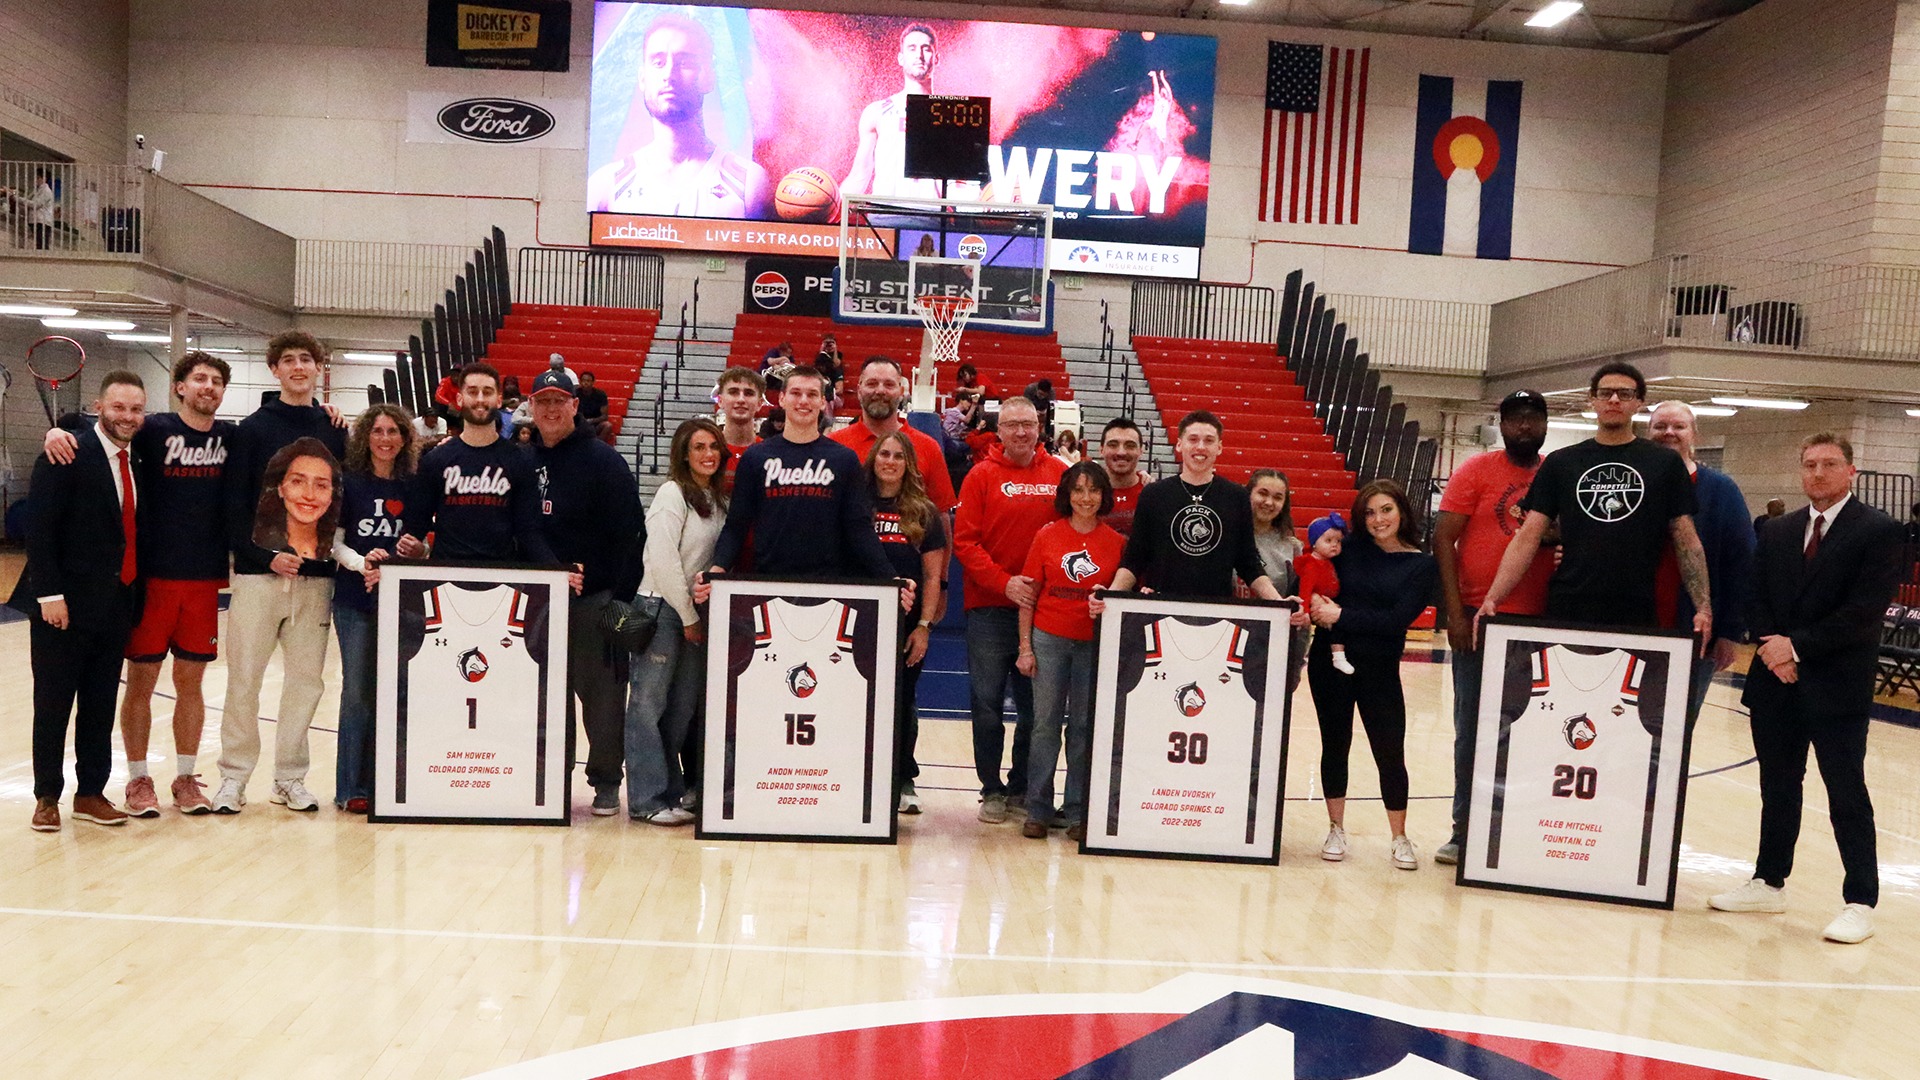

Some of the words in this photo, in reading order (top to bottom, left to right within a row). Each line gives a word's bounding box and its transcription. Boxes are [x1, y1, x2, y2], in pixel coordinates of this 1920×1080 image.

[470, 31, 510, 41] BARBECUE
[511, 33, 525, 42] PIT
[460, 104, 532, 135] Ford
[930, 103, 982, 127] 5:00
[946, 144, 1182, 214] WERY
[609, 221, 678, 239] uchealth
[706, 229, 740, 243] LIVE
[746, 231, 886, 251] EXTRAORDINARY
[960, 245, 985, 253] PEPSI
[1106, 250, 1180, 263] FARMERS
[1105, 262, 1155, 271] INSURANCE
[754, 285, 788, 295] PEPSI
[164, 434, 228, 466] Pueblo
[763, 457, 835, 487] Pueblo
[443, 465, 511, 495] Pueblo
[765, 486, 833, 498] BASKETBALL
[1014, 483, 1058, 496] PACK
[374, 498, 384, 517] I
[1185, 507, 1211, 516] PACK
[1180, 542, 1211, 553] BASKETBALL
[466, 697, 477, 729] 1
[784, 713, 817, 746] 15
[1167, 731, 1209, 765] 30
[446, 751, 463, 759] SAM
[464, 752, 497, 760] HOWERY
[428, 765, 467, 774] COLORADO
[502, 767, 513, 775] CO
[767, 768, 793, 776] ANDON
[794, 768, 829, 777] MINDRUP
[450, 780, 491, 788] 2022-2026
[756, 781, 795, 790] COLORADO
[830, 783, 841, 792] CO
[1552, 764, 1598, 800] 20
[1152, 788, 1180, 797] LANDEN
[1181, 789, 1216, 799] DVORSKY
[777, 796, 819, 805] 2022-2026
[1140, 801, 1179, 811] COLORADO
[1214, 806, 1225, 815] CO
[1161, 817, 1202, 827] 2022-2026
[1538, 819, 1565, 829] KALEB
[1565, 821, 1602, 833] MITCHELL
[1585, 839, 1597, 847] CO
[1545, 849, 1590, 861] 2025-2026
